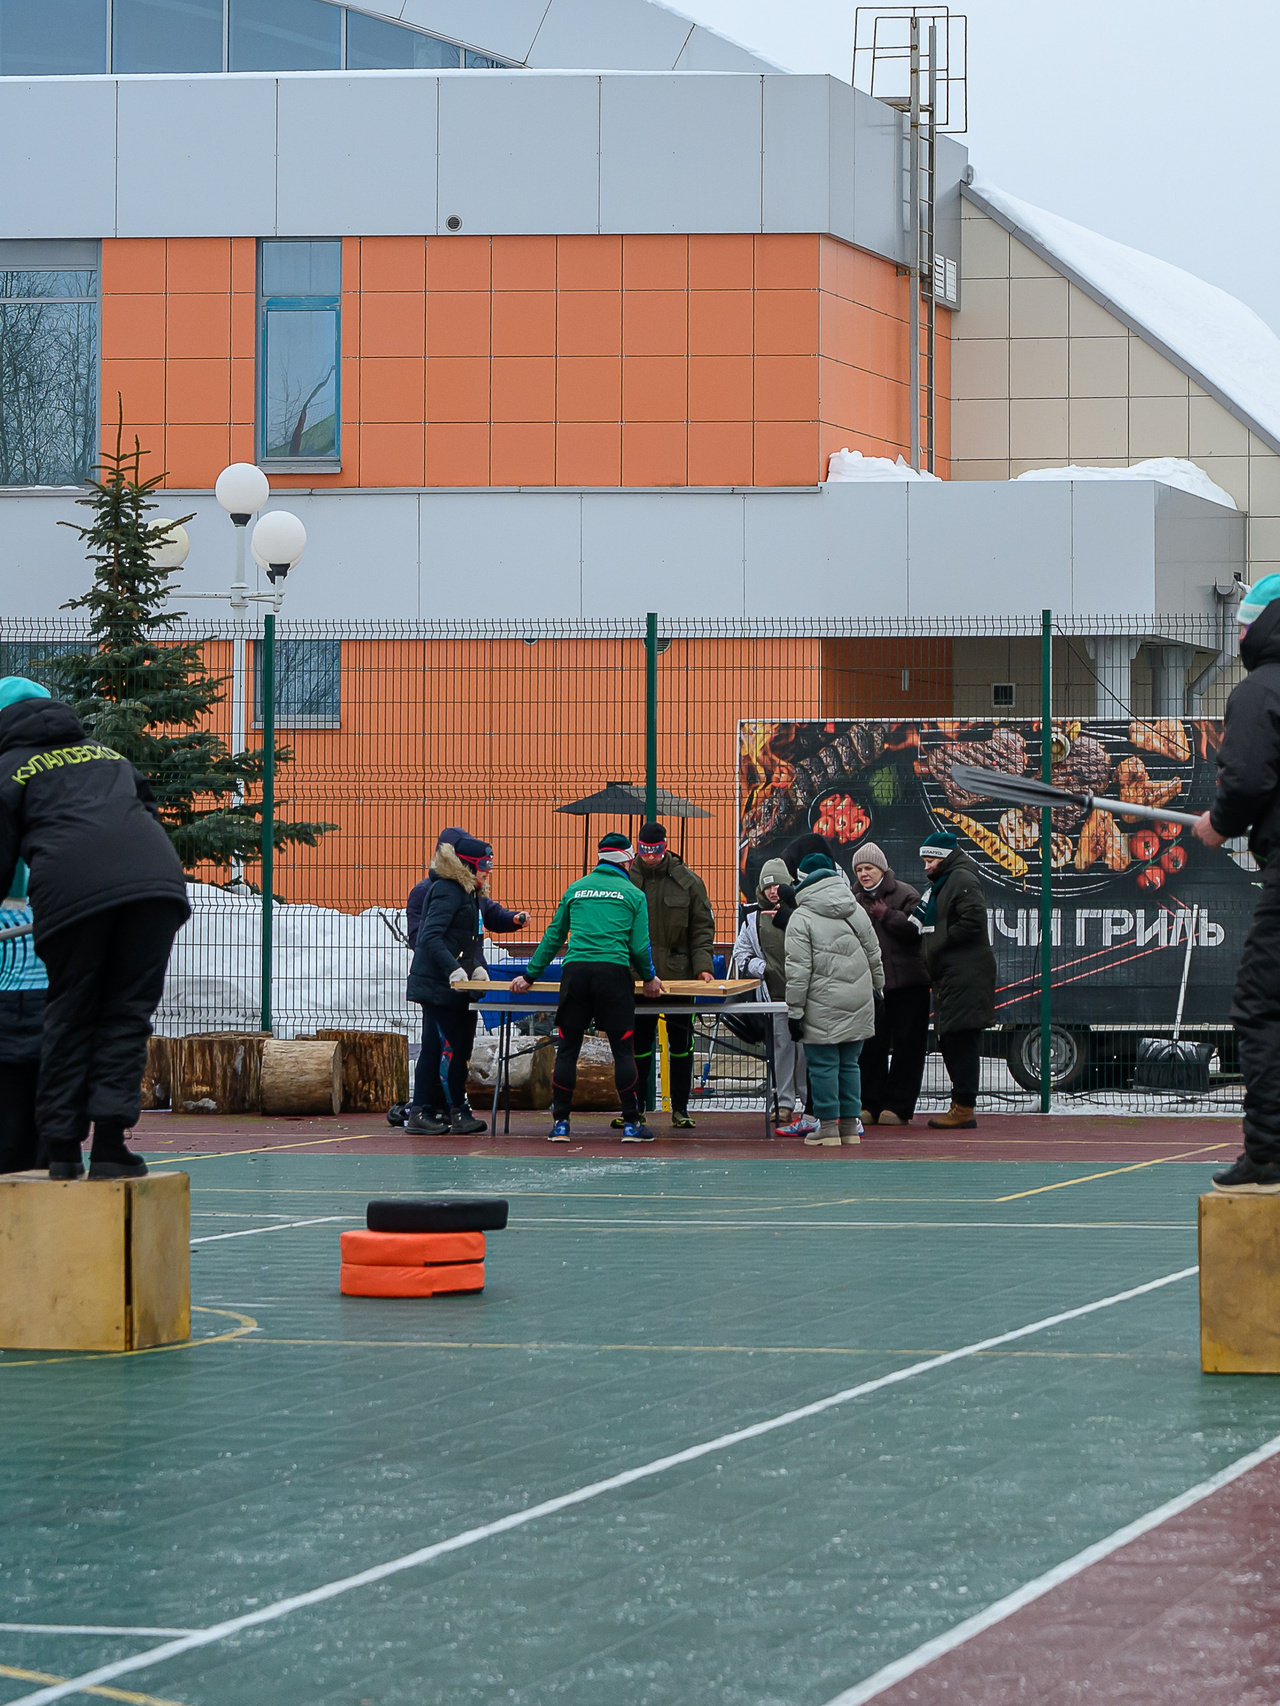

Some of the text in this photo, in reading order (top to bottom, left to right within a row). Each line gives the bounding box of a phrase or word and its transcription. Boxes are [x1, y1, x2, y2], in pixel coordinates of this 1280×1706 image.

[11, 745, 127, 785] КУПАЛОВСКО
[574, 890, 625, 900] БЕЛАРУСЬ
[986, 908, 1226, 947] ЧИ ГРИЛЬ
